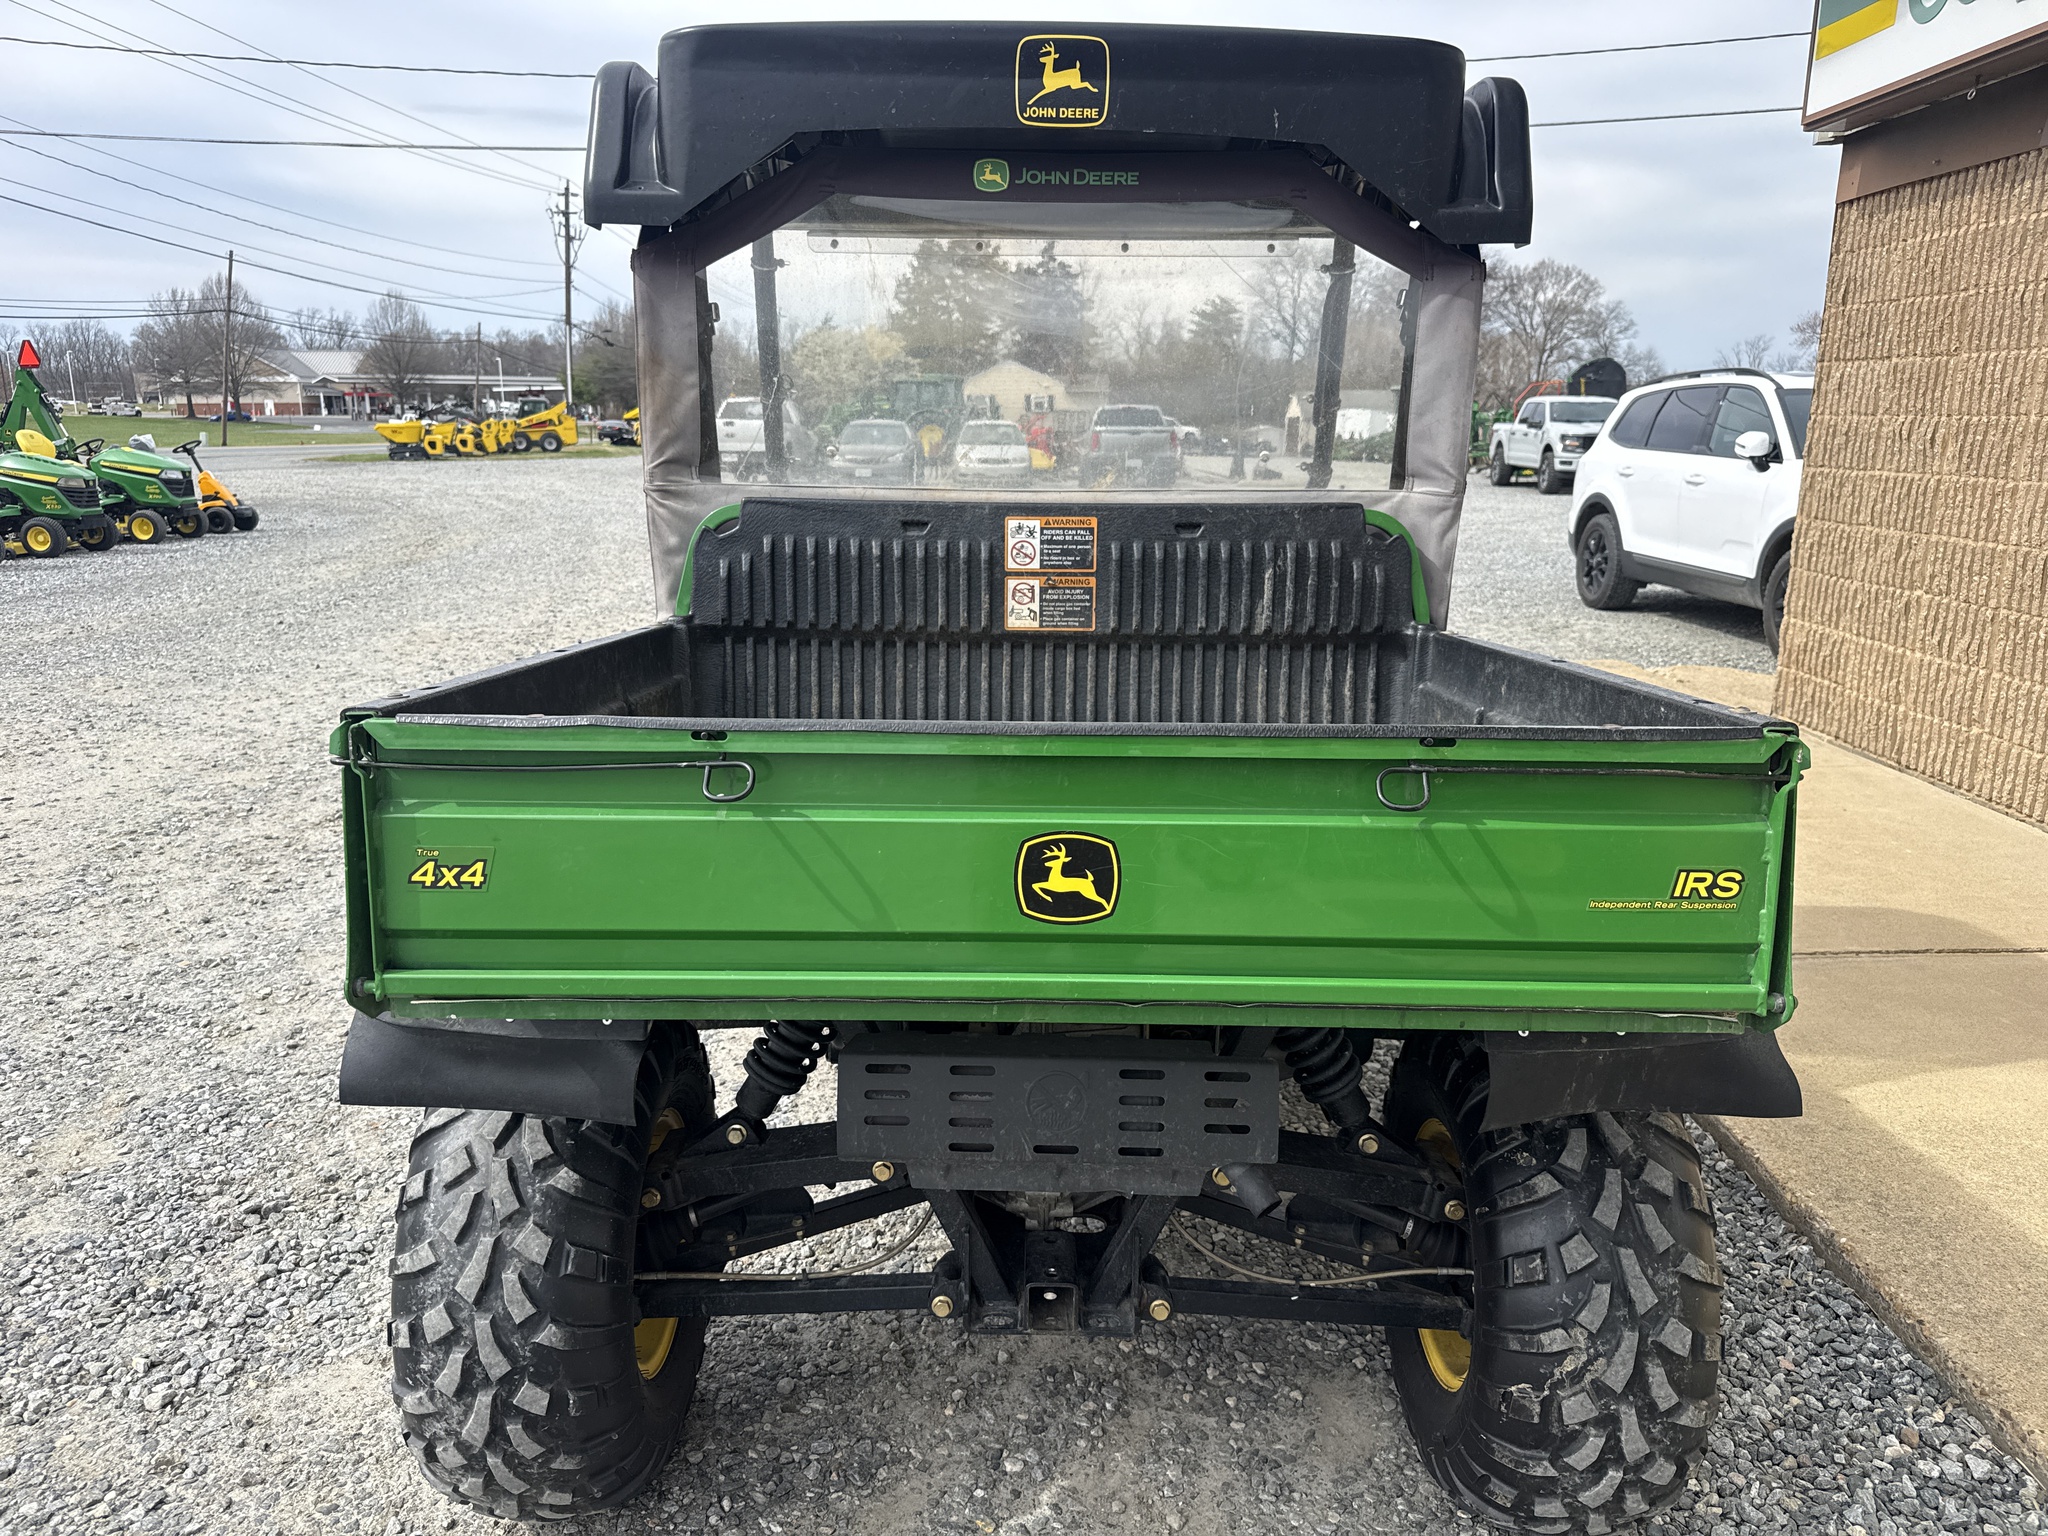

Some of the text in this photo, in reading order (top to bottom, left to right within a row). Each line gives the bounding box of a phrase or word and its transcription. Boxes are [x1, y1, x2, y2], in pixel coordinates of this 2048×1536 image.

[1023, 107, 1099, 119] JOHN DEERE
[1015, 167, 1139, 186] JOHN DEERE
[1051, 518, 1092, 526] WARNING
[416, 848, 440, 857] True
[410, 860, 486, 888] 4x4
[1672, 870, 1745, 899] IRS
[1589, 900, 1737, 911] Independent Rear Suspension
